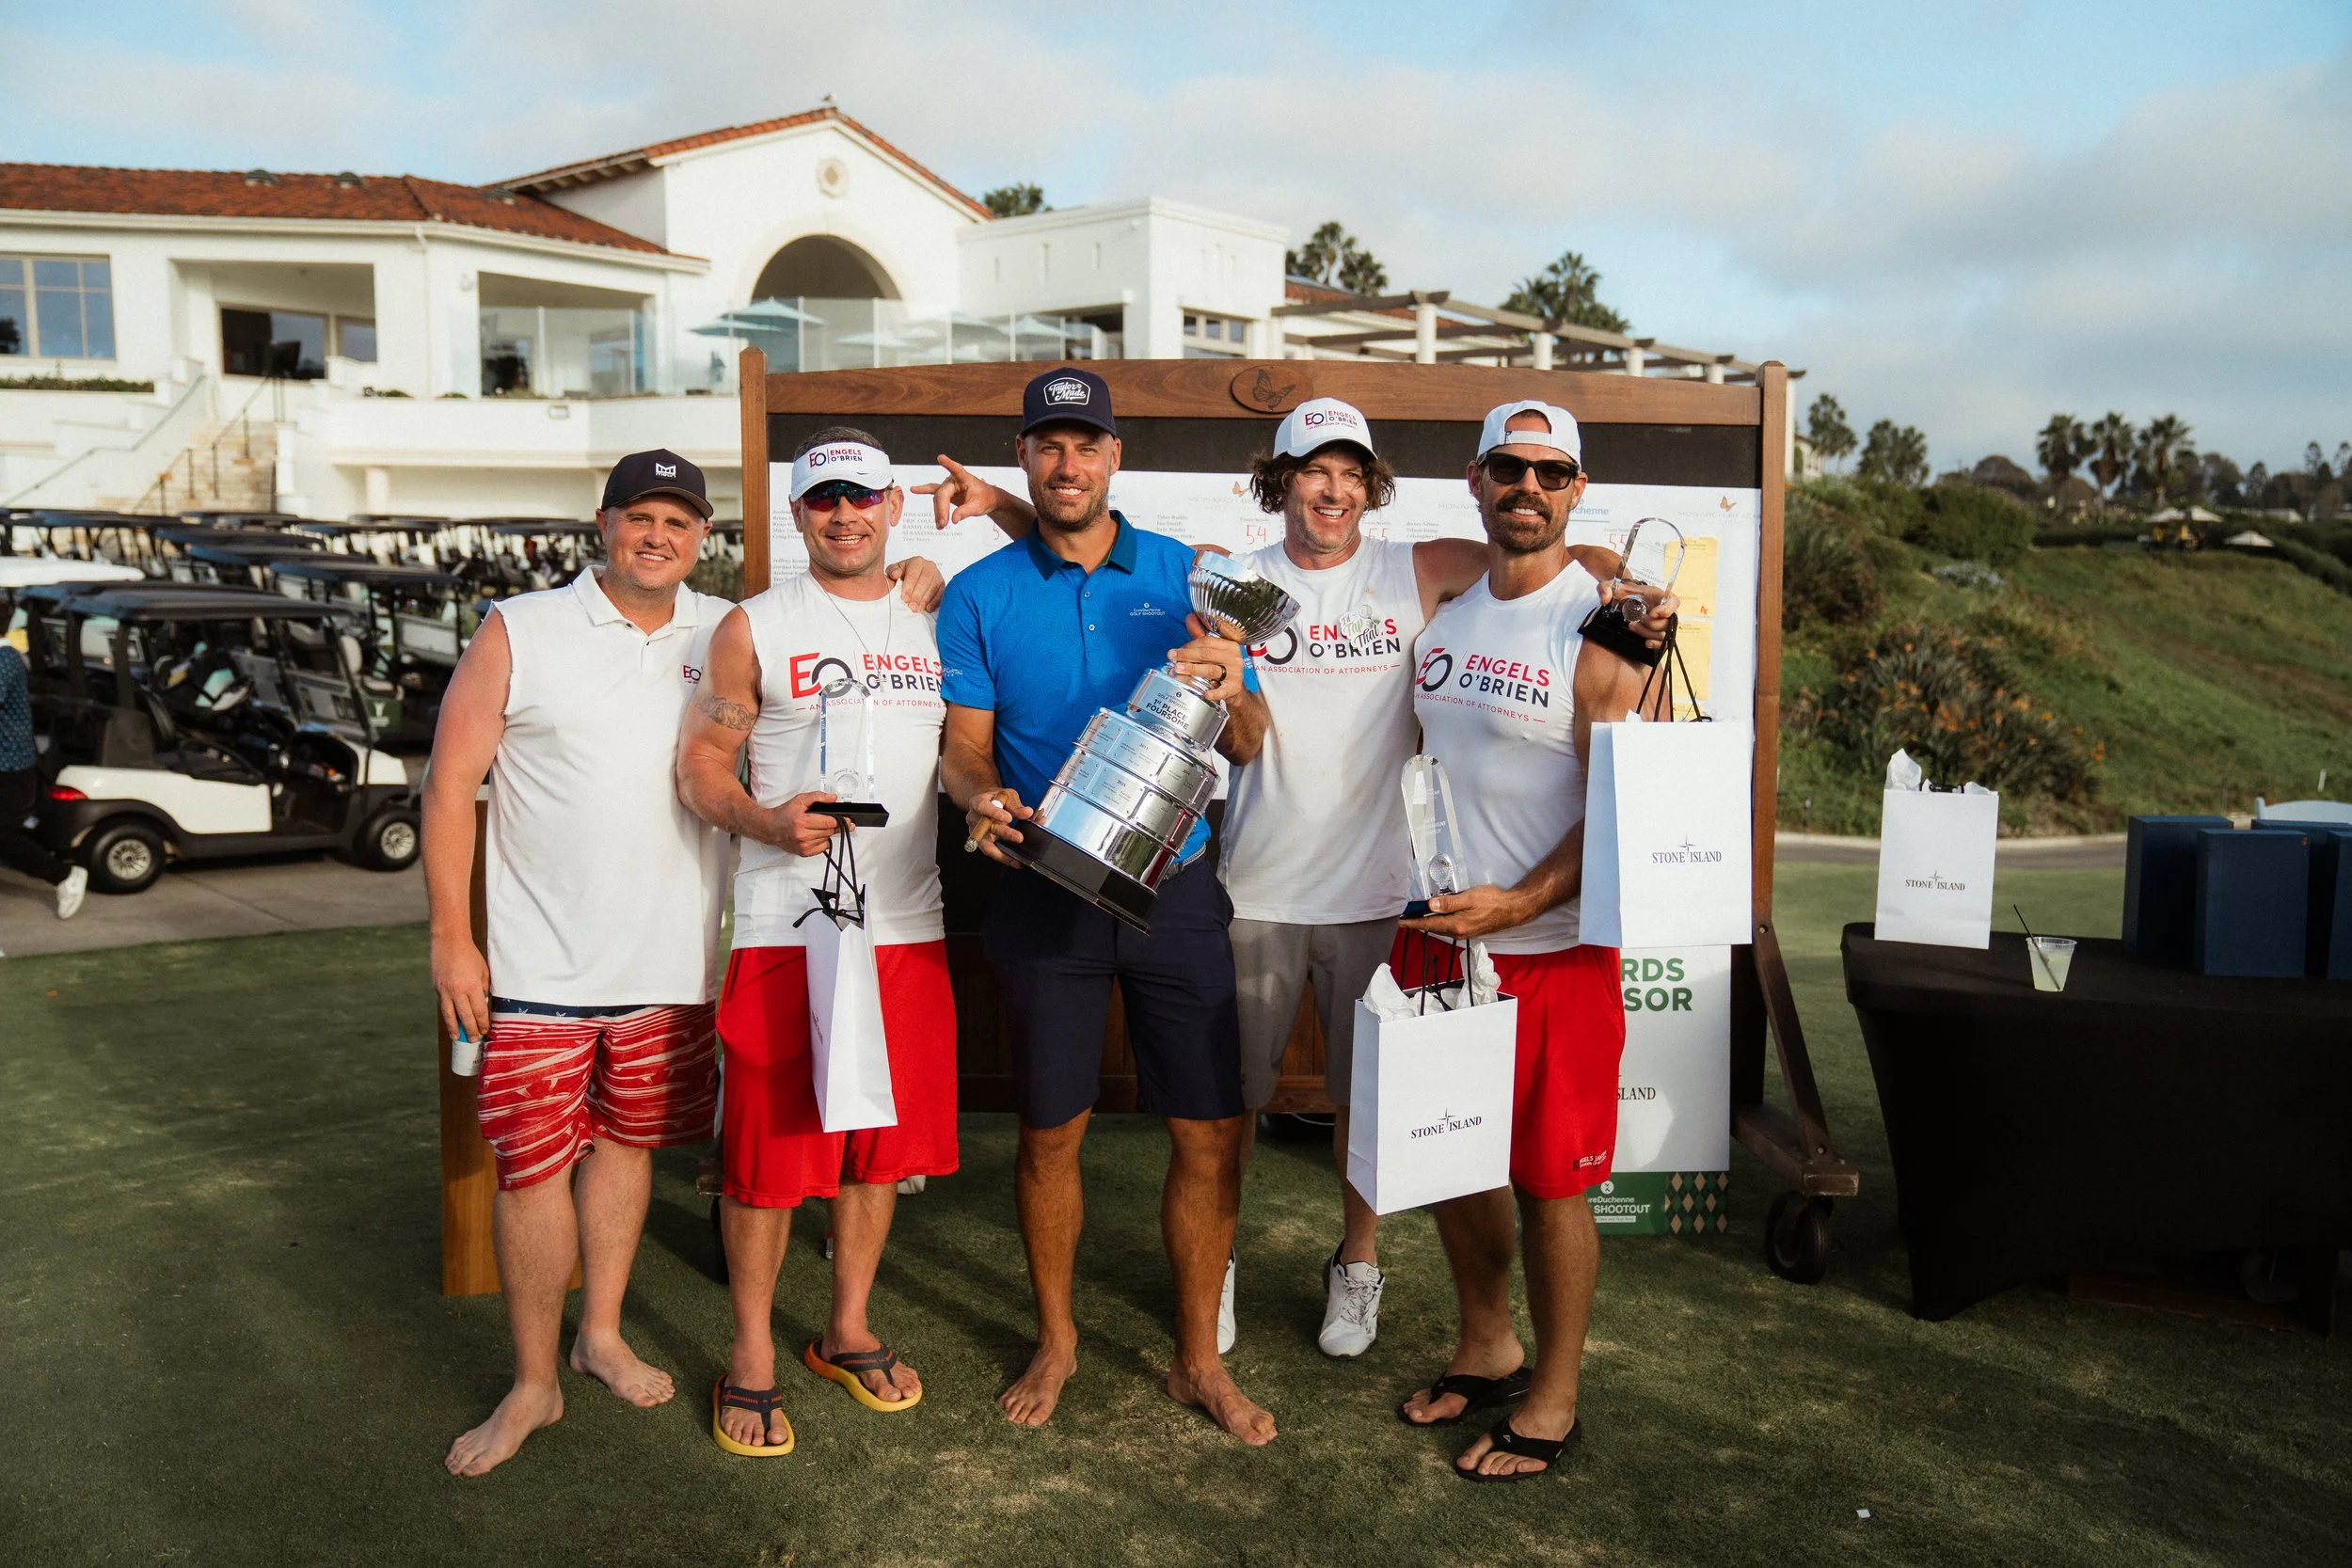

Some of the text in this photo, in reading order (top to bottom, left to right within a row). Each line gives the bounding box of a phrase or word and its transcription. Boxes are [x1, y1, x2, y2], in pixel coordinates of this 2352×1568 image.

[1048, 381, 1076, 396] Taylor
[1054, 388, 1086, 401] Made
[1305, 410, 1357, 425] EO ENGELS
[1328, 416, 1358, 426] O'BRIEN
[809, 451, 827, 467] EO
[1245, 524, 1266, 545] 54
[1354, 624, 1378, 647] That
[863, 654, 942, 676] ENGELS
[1339, 664, 1389, 674] ATTORNEYS
[1466, 654, 1550, 687] ENGELS
[1459, 673, 1549, 707] O'BRIEN
[897, 700, 941, 708] ATTORNEYS
[1161, 703, 1189, 721] PLACE
[1421, 692, 1464, 705] ASSOCIATION
[1466, 699, 1475, 707] OF
[1477, 703, 1530, 721] ATTORNEYS
[1145, 702, 1190, 731] FOURSOME
[1652, 850, 1722, 863] STONE ISLAND
[1905, 879, 1965, 891] STONE ISLAND
[1620, 958, 1685, 982] RDS
[1624, 988, 1692, 1012] SOR
[1411, 1116, 1482, 1139] STONE ISLAND
[1594, 1204, 1651, 1213] SHOOTOUT
